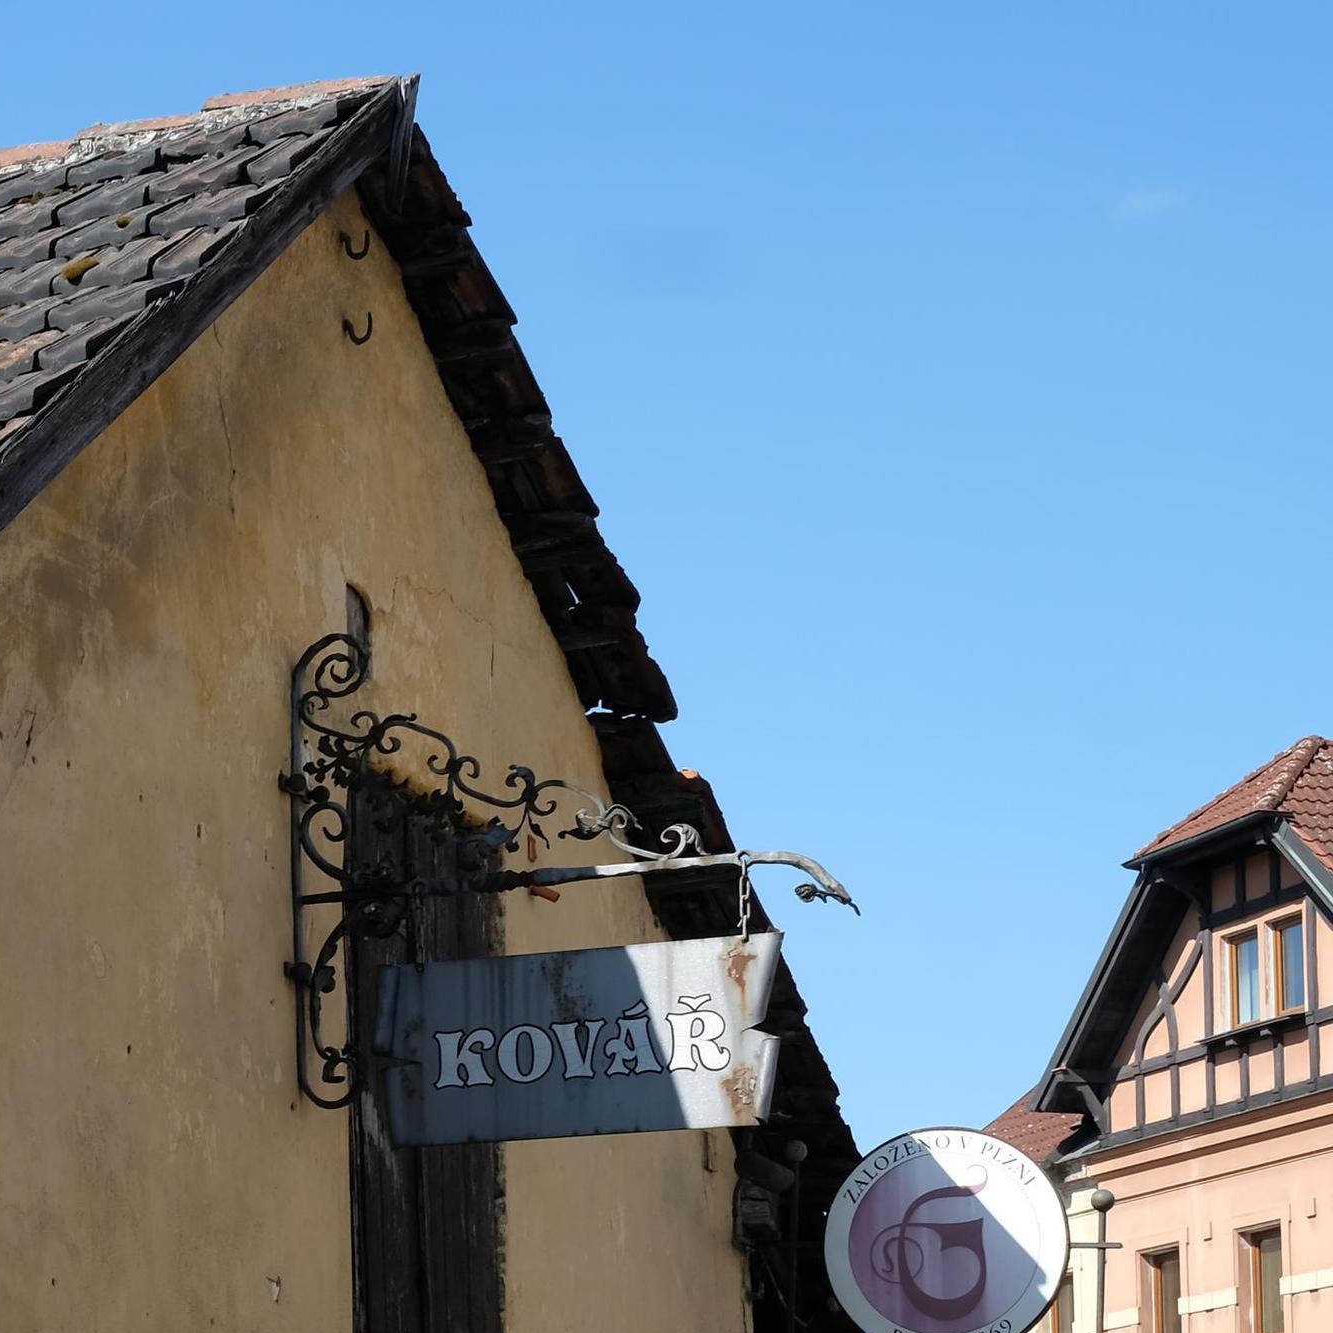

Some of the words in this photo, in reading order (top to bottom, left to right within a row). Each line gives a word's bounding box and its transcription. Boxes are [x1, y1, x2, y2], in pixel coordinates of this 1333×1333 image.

[434, 994, 731, 1090] KOVÁŘ
[843, 1135, 950, 1205] ZALOŽENO
[958, 1136, 974, 1150] V
[981, 1141, 1037, 1186] PLZNI
